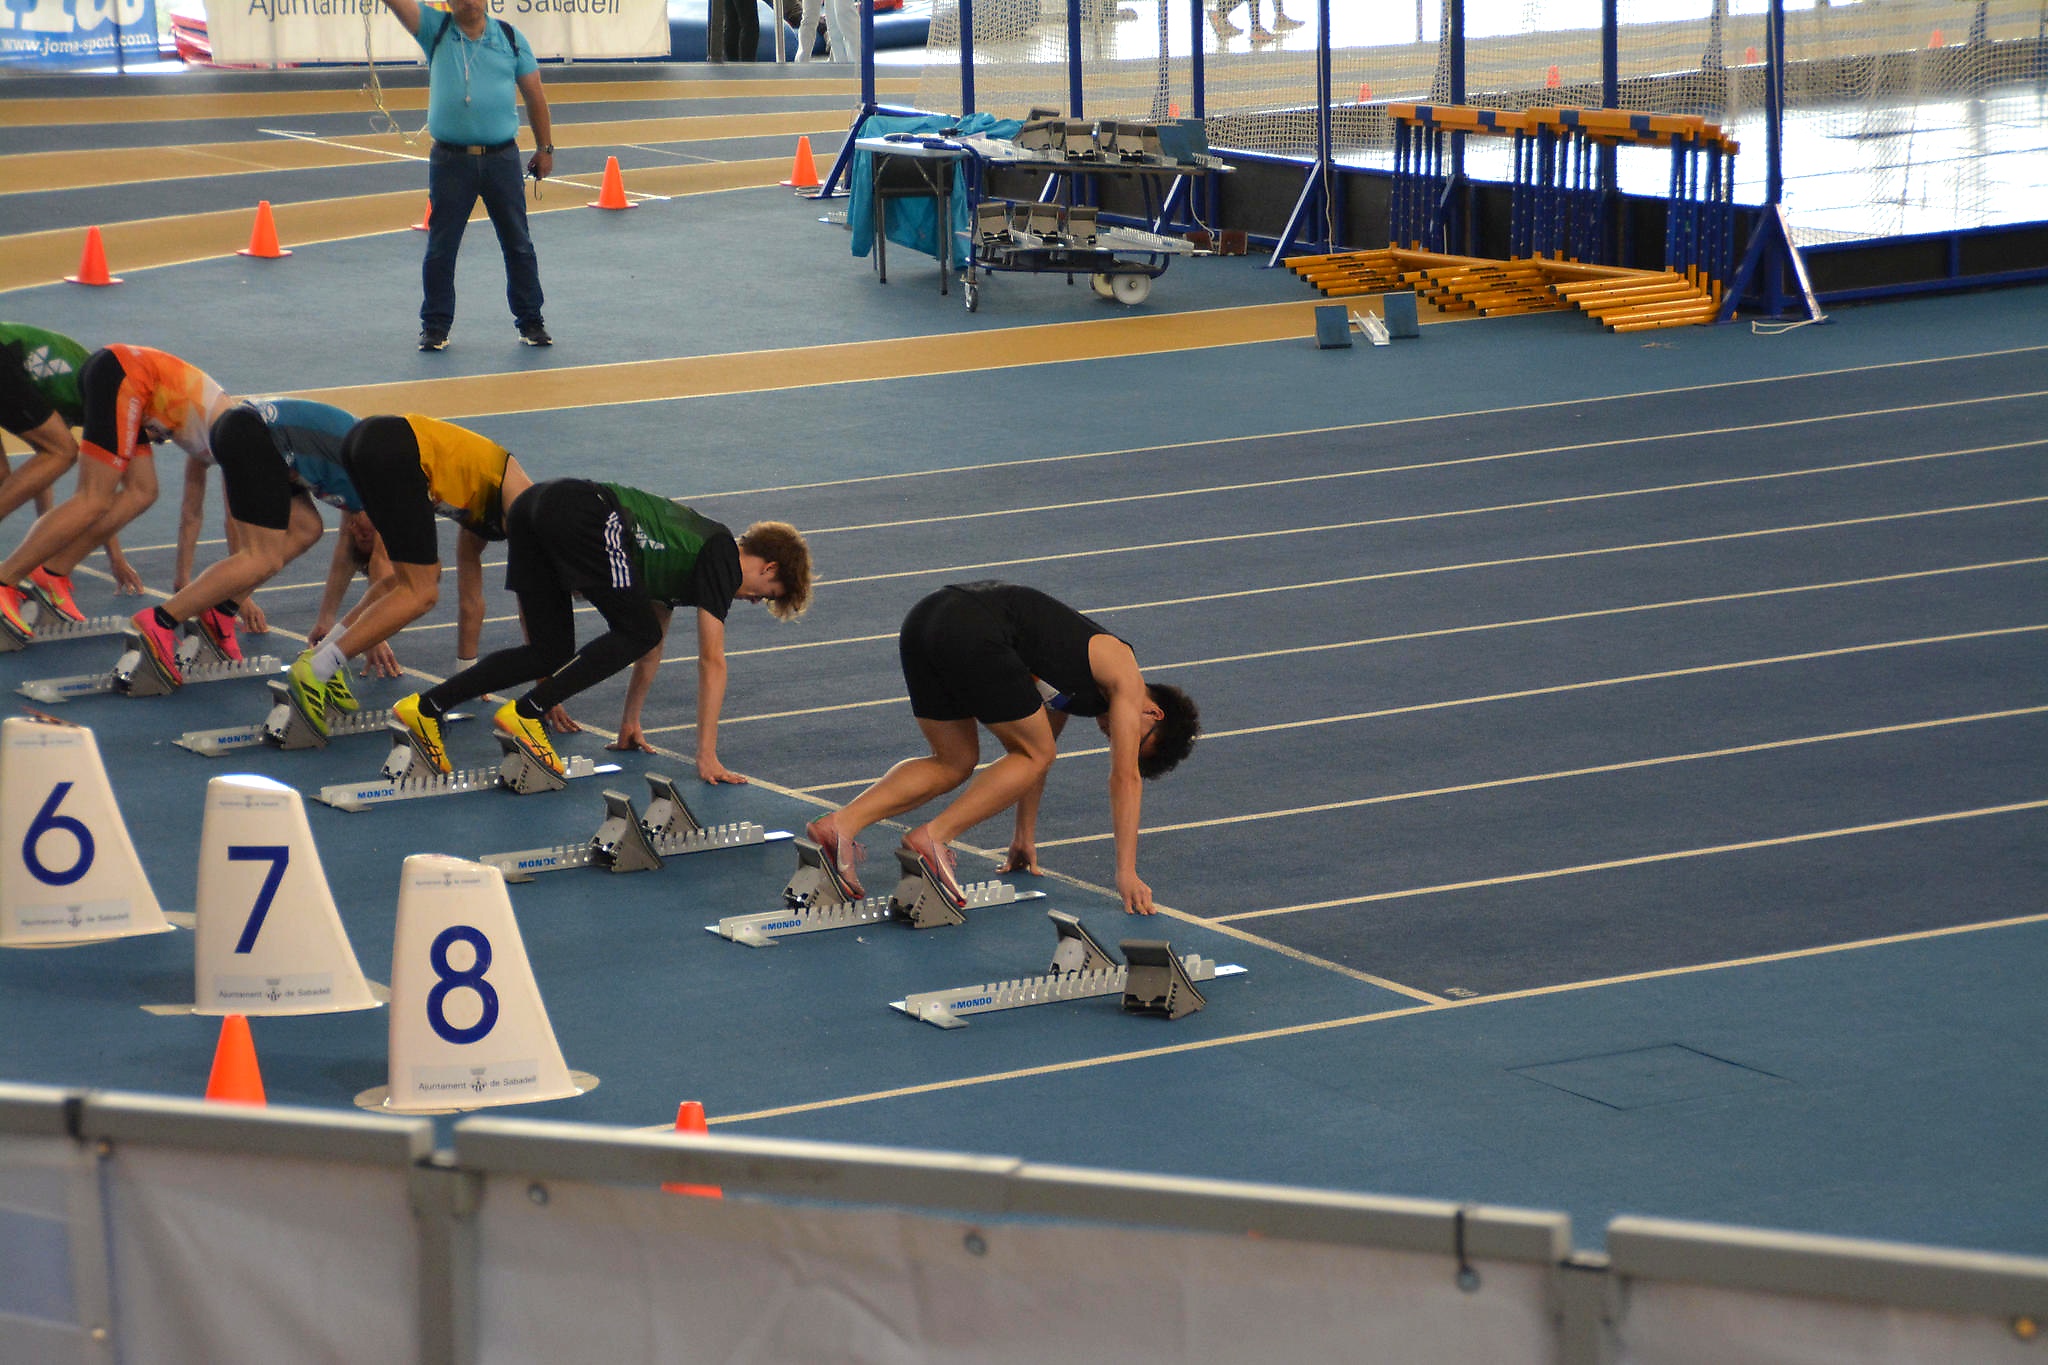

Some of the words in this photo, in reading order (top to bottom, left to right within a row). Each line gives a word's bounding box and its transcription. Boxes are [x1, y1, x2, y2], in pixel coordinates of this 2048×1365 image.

[1, 33, 151, 56] www.joma-sport.com
[22, 782, 95, 886] 6
[227, 845, 289, 954] 7
[767, 919, 801, 931] MONDO
[426, 925, 499, 1045] 8
[957, 996, 992, 1009] MONDO
[418, 1081, 467, 1092] Ajuntament
[489, 1079, 500, 1088] de
[503, 1075, 537, 1088] Sabadell
